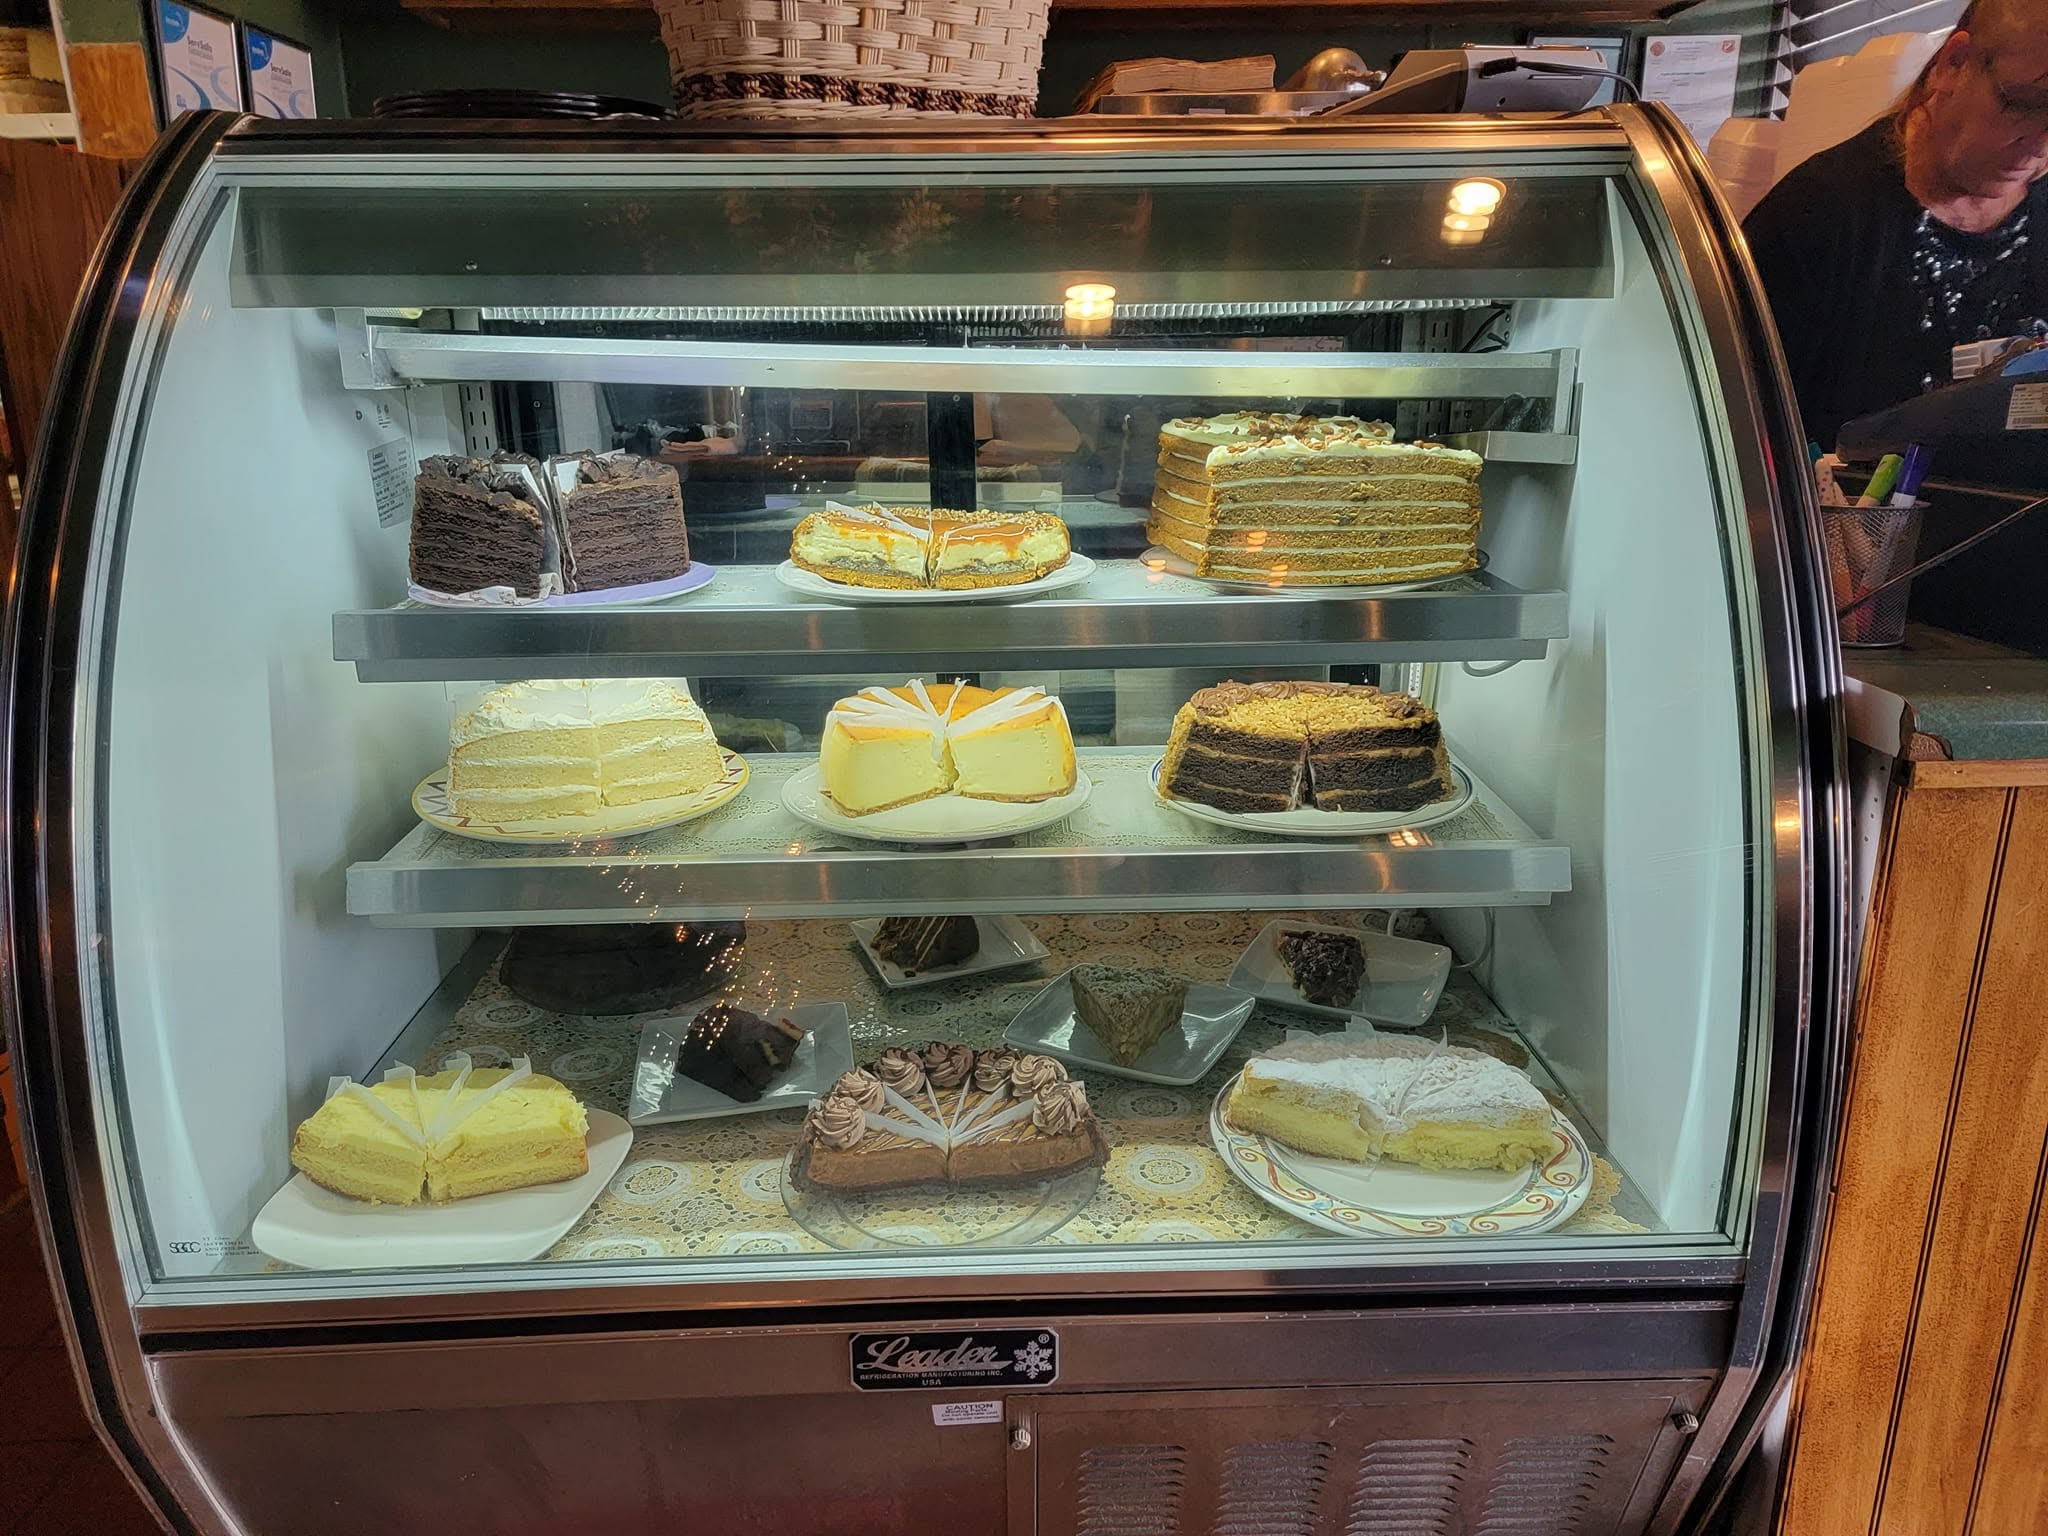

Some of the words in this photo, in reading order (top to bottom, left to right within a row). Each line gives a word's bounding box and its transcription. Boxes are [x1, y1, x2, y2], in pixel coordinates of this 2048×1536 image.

[856, 1336, 1013, 1373] Leader
[860, 1372, 919, 1380] REFRIGERATION
[921, 1371, 985, 1379] MANUFACTURING
